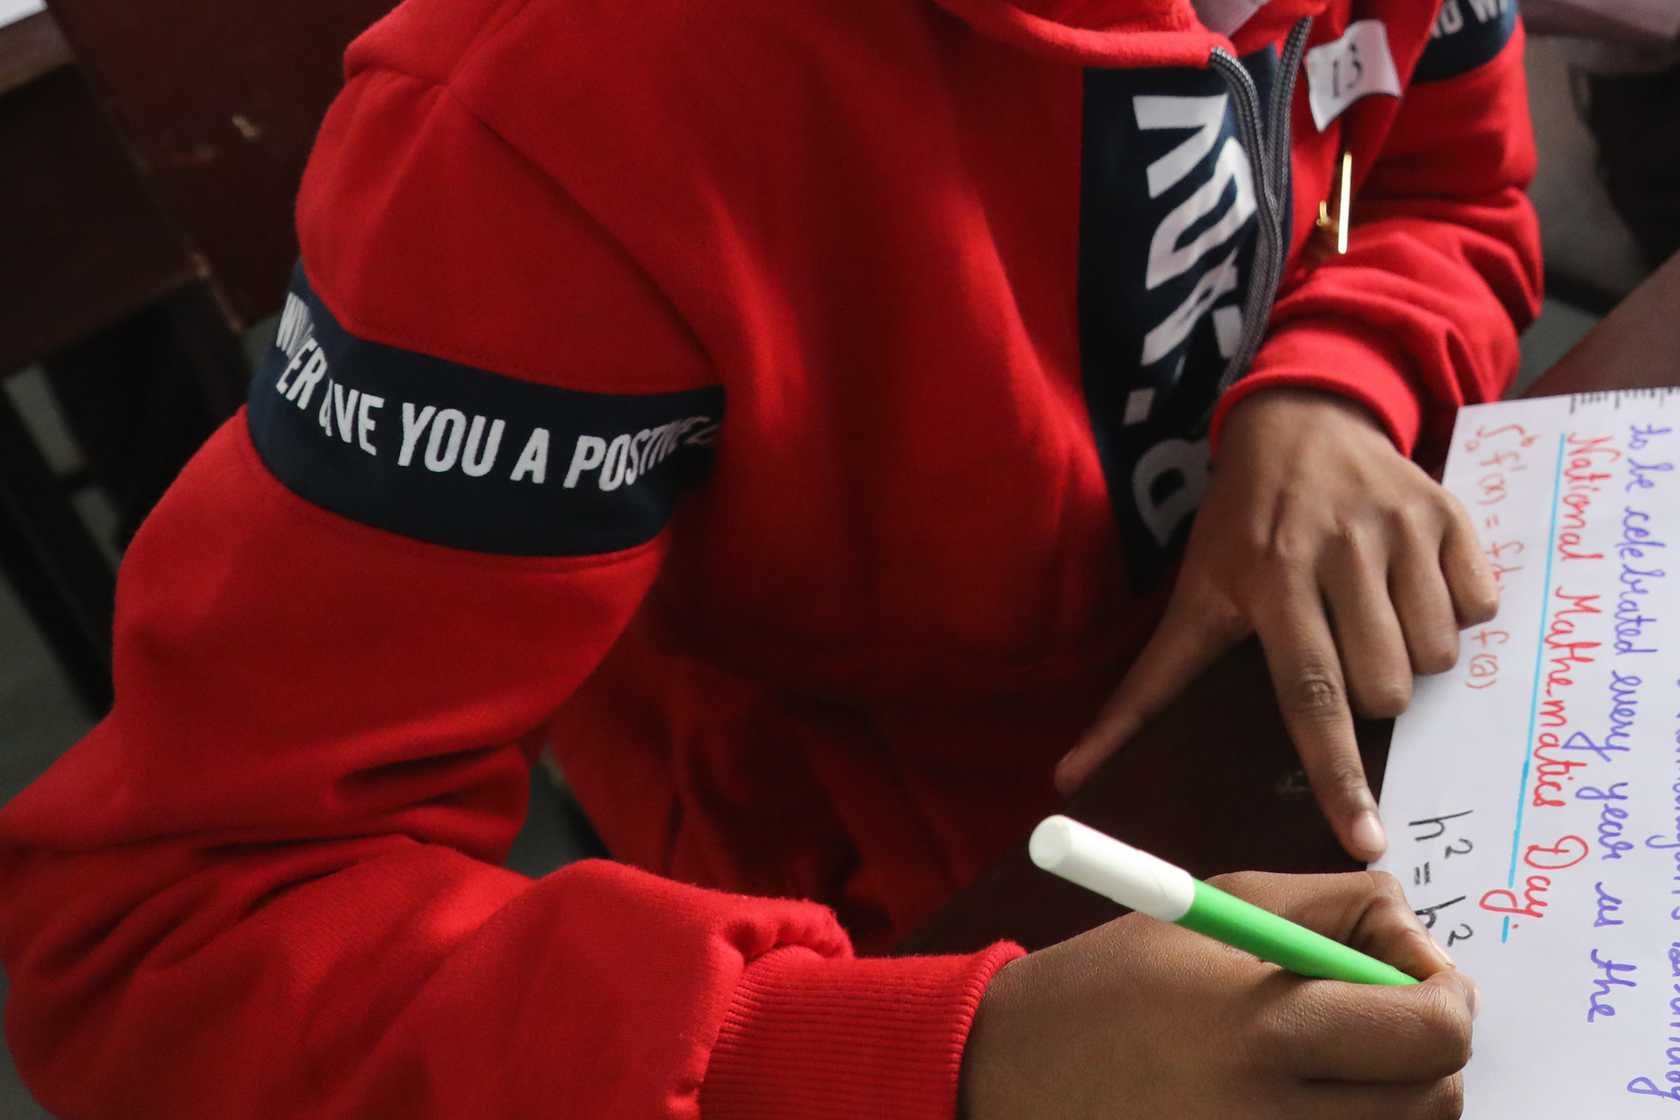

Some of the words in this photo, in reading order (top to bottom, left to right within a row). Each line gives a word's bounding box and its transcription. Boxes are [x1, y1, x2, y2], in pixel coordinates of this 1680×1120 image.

[398, 401, 506, 478] YOU
[510, 427, 551, 484] A
[1624, 457, 1674, 494] be
[1627, 424, 1672, 451] to
[1556, 432, 1622, 562] National
[1614, 506, 1667, 657] celebrated
[1533, 585, 1602, 809] Mathematics
[1562, 670, 1643, 763] every
[1575, 782, 1635, 861] year
[1593, 881, 1625, 928] as
[1587, 948, 1637, 1023] the
